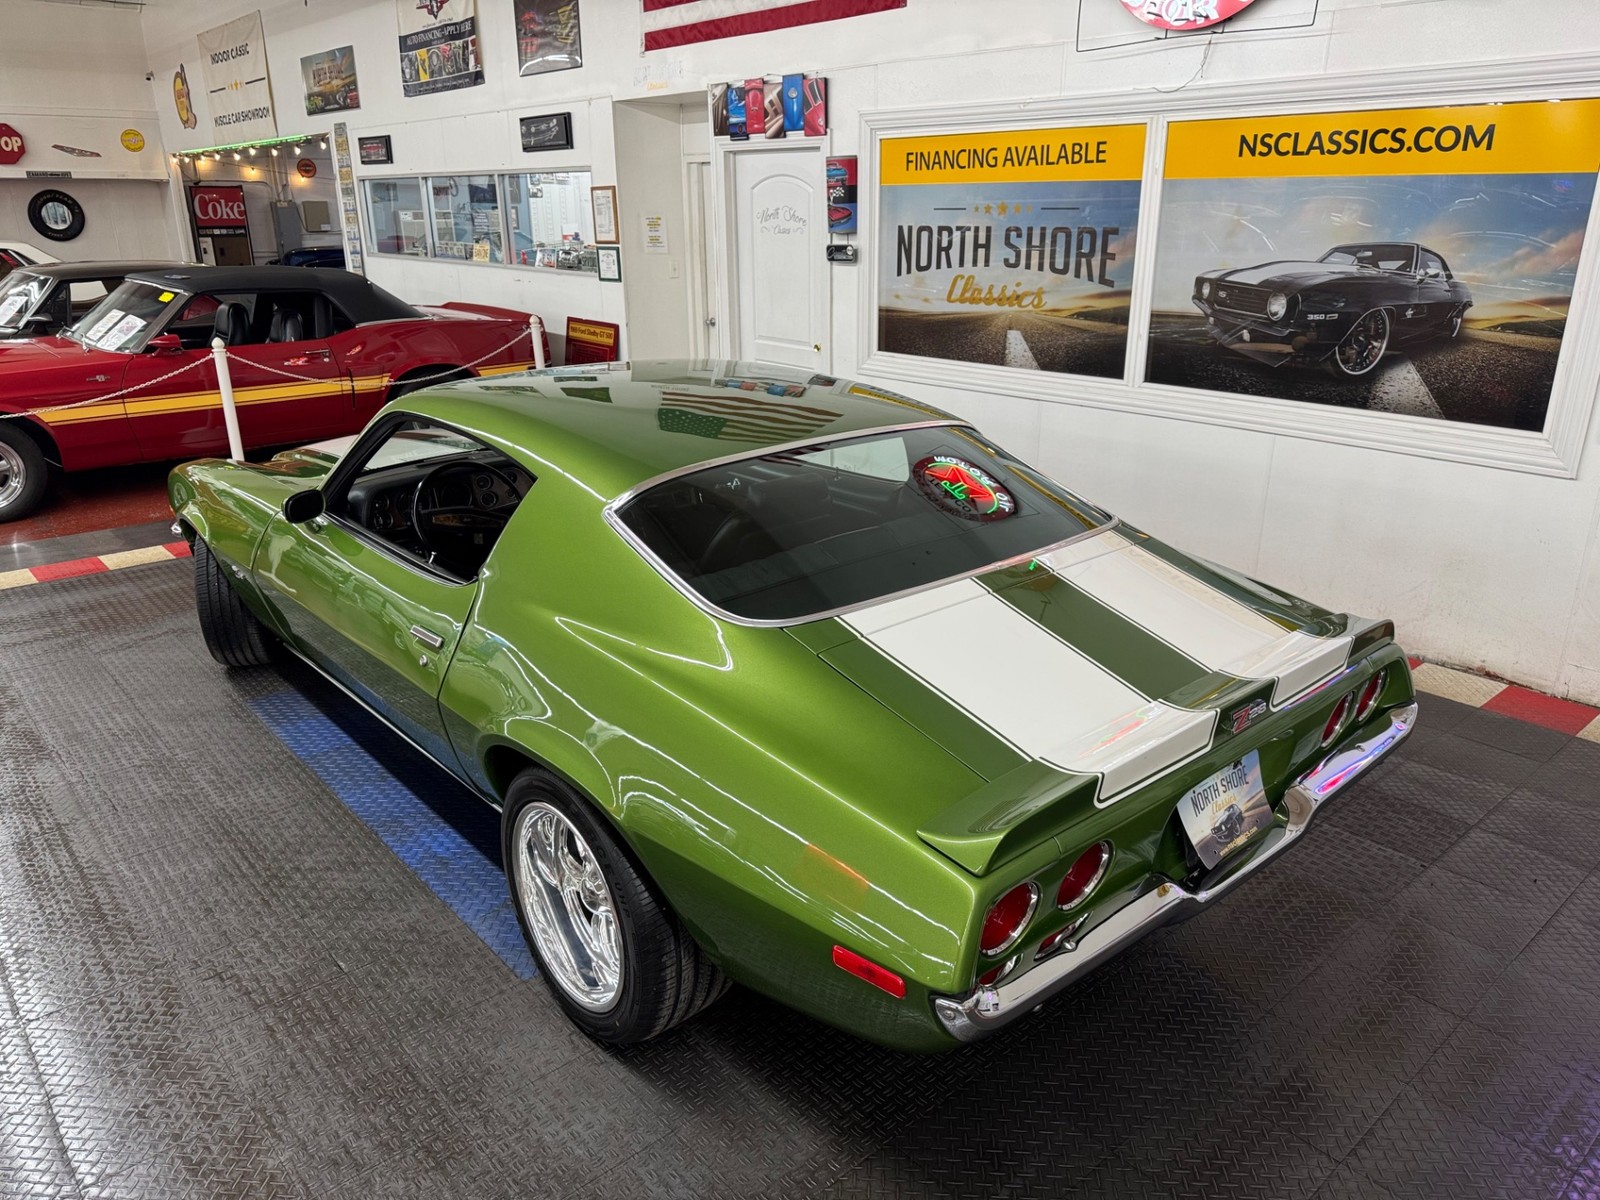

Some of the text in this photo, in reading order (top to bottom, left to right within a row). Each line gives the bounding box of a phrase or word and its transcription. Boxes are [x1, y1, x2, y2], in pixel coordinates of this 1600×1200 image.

[460, 20, 472, 33] HERE
[210, 48, 230, 65] INDOOR
[214, 106, 271, 127] MUSCLE CAR SHOWROOM
[0, 136, 22, 152] OP
[1238, 123, 1496, 158] NSCLASSICS.COM
[905, 141, 1107, 172] FINANCING AVAILABLE
[194, 193, 246, 220] Coke
[896, 225, 1120, 288] NORTH SHORE
[946, 274, 1048, 309] Classics
[1232, 699, 1267, 735] Z28
[1190, 765, 1249, 817] NORTH SHORE
